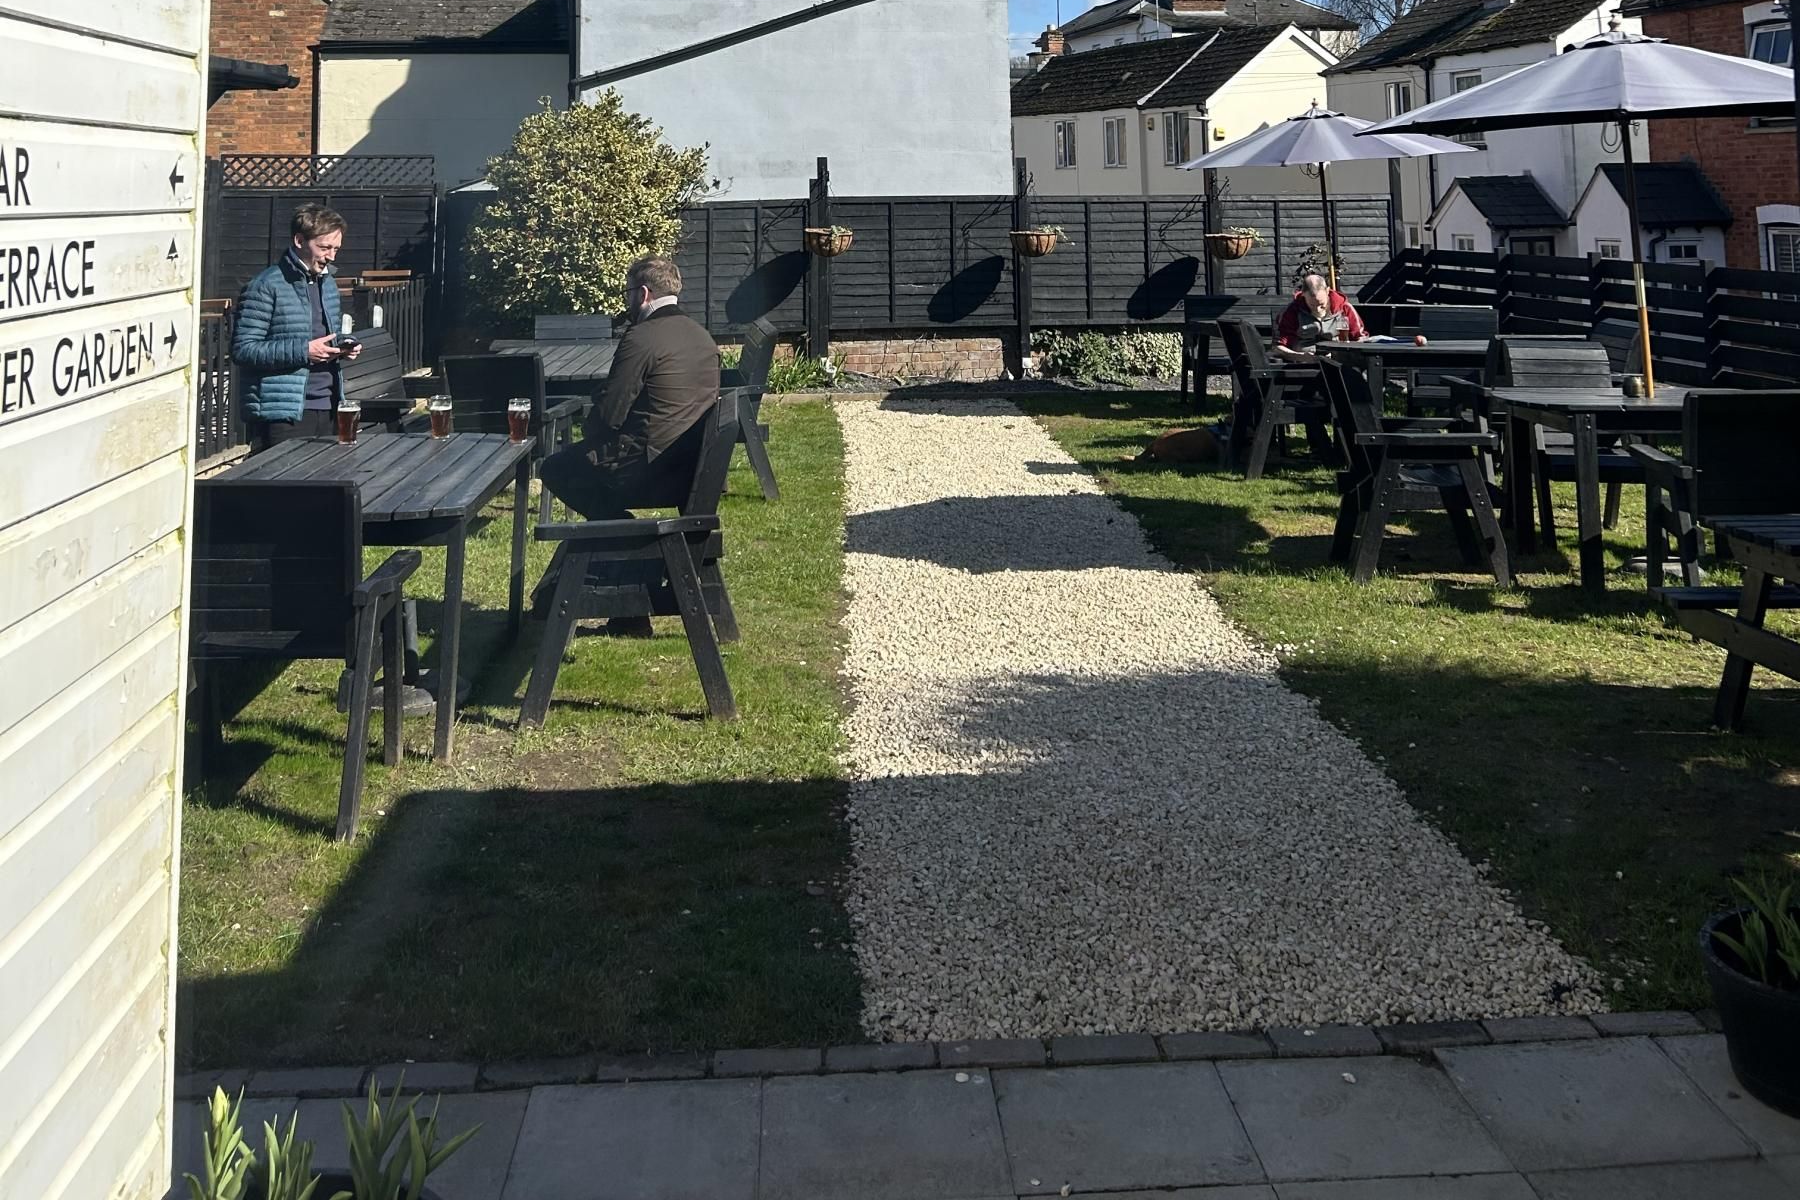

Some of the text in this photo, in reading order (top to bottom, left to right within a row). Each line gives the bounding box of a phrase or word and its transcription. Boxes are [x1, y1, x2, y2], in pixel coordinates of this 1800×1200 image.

[0, 144, 31, 206] AR
[0, 322, 154, 413] ER GARDEN
